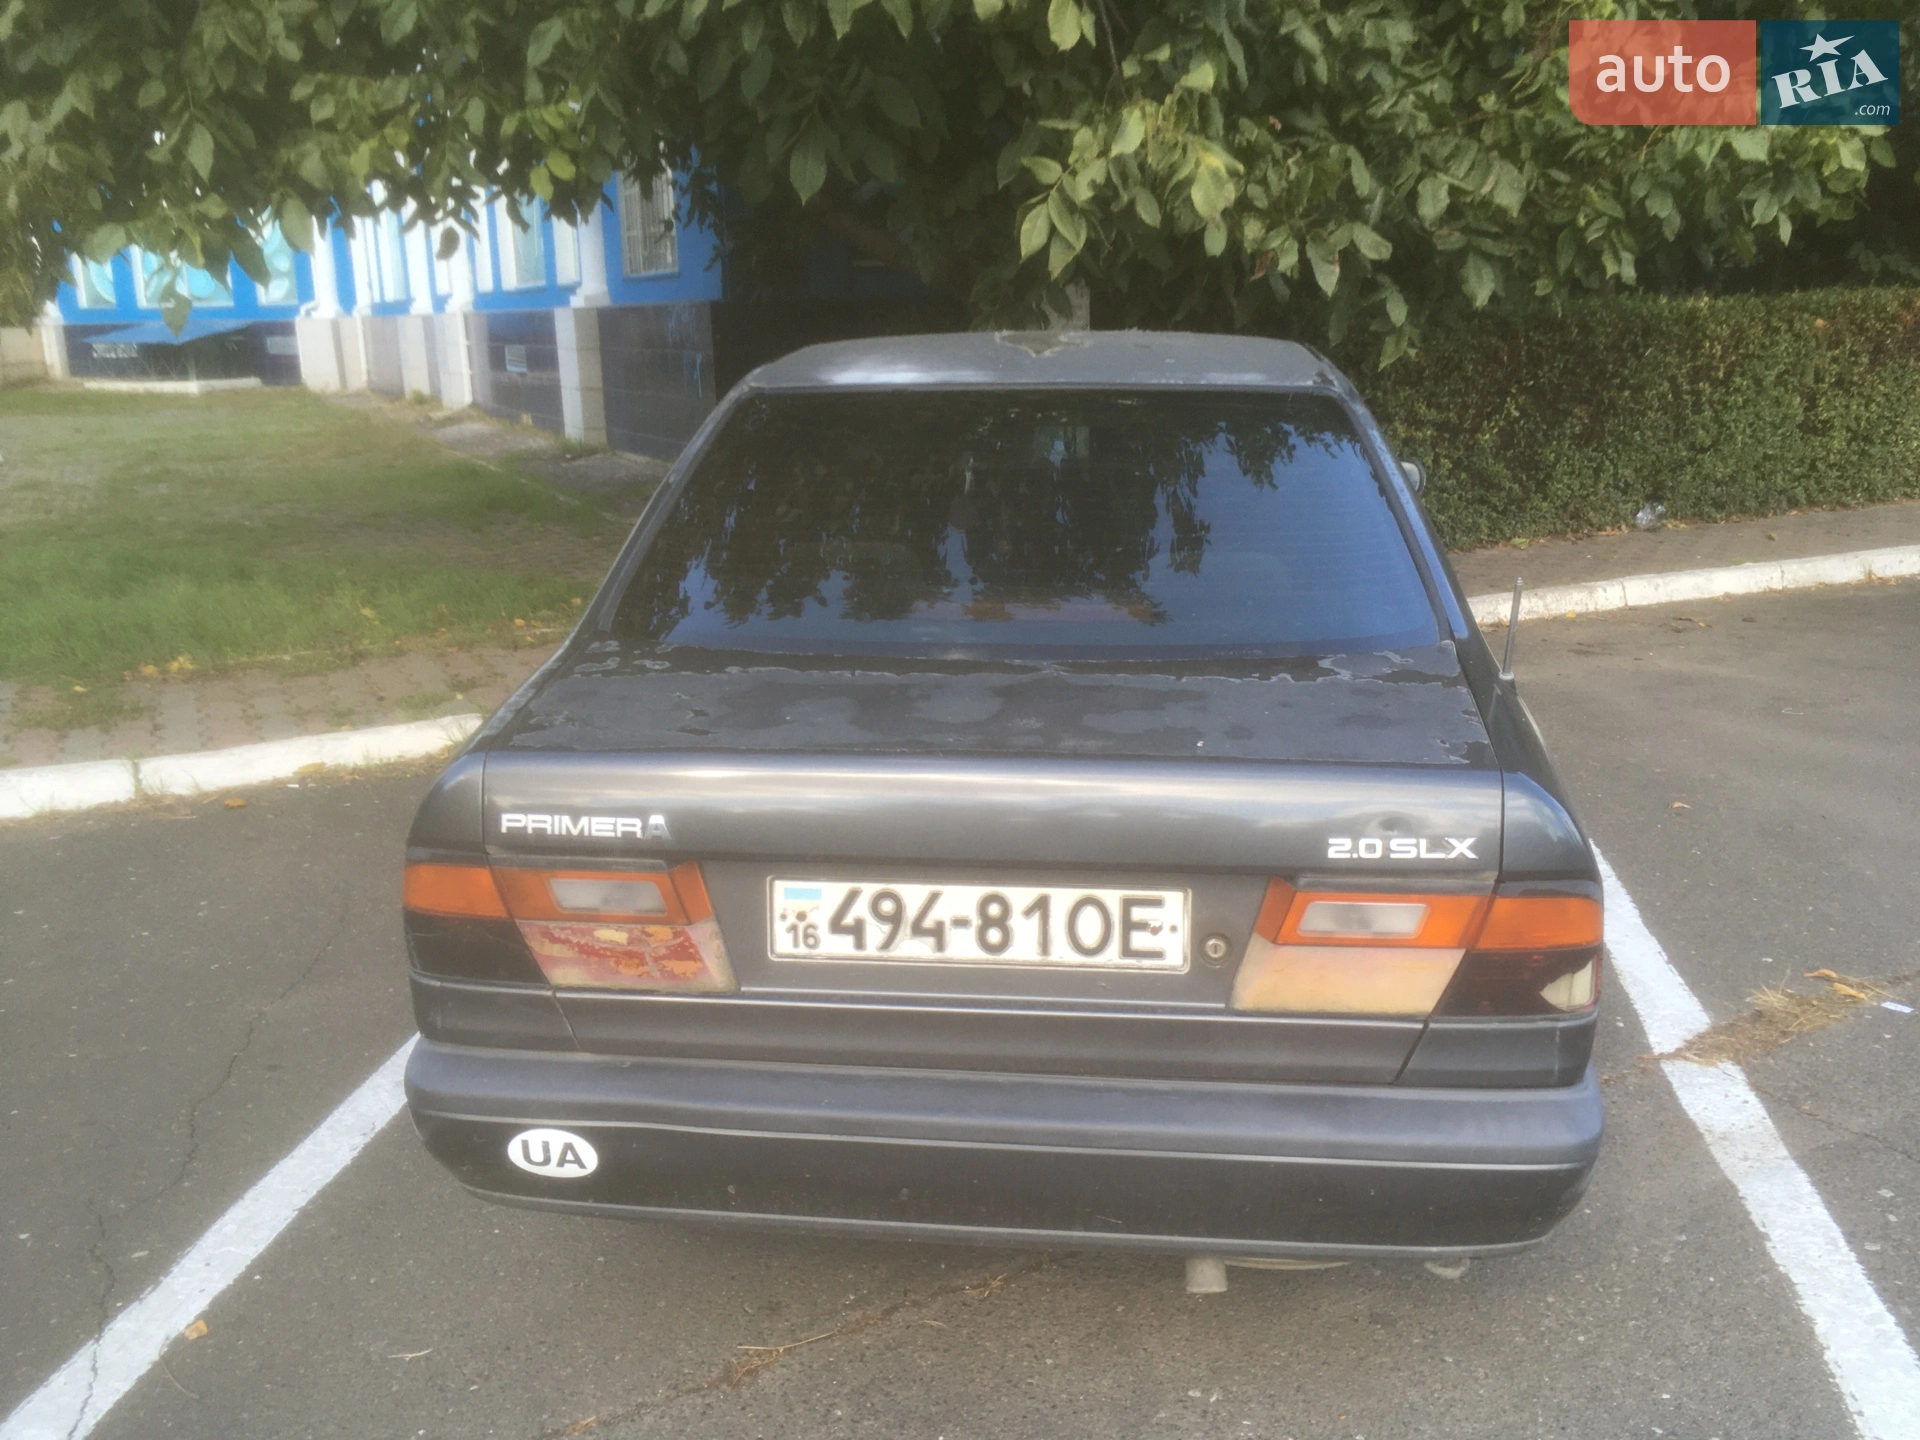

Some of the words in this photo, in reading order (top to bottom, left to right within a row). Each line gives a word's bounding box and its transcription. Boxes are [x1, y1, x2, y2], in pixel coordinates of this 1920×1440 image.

[501, 813, 671, 840] PRIMERA
[1327, 837, 1382, 859] 2.0
[1389, 837, 1478, 860] SLX
[786, 924, 821, 951] 16
[520, 1139, 588, 1170] UA
